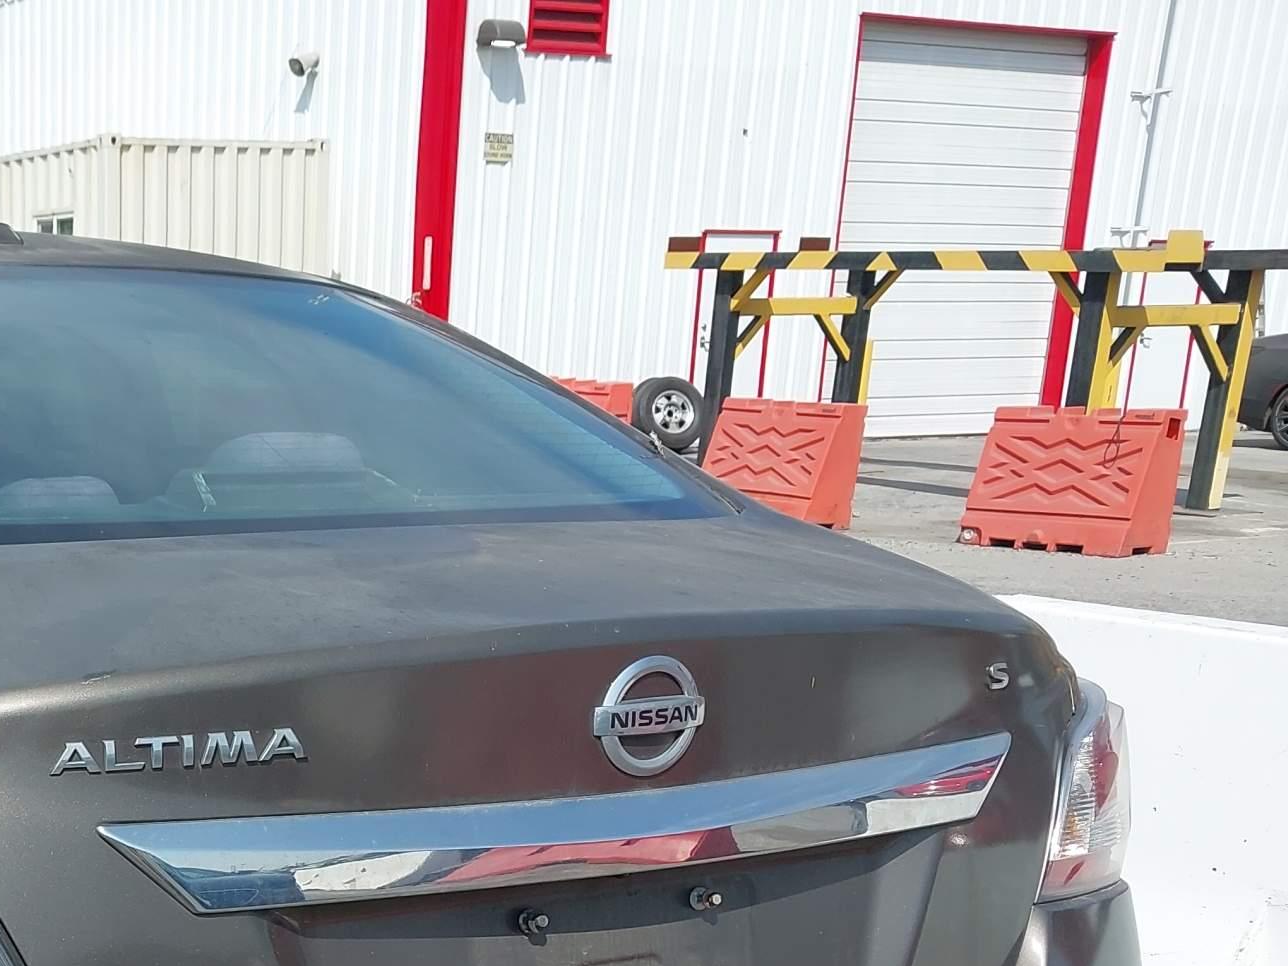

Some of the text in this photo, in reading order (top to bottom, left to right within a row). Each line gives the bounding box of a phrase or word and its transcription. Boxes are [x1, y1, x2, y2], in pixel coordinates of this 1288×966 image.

[485, 133, 513, 143] CAUTION
[985, 662, 1010, 690] S
[610, 704, 698, 730] NISSAN
[49, 727, 309, 777] ALTIMA
